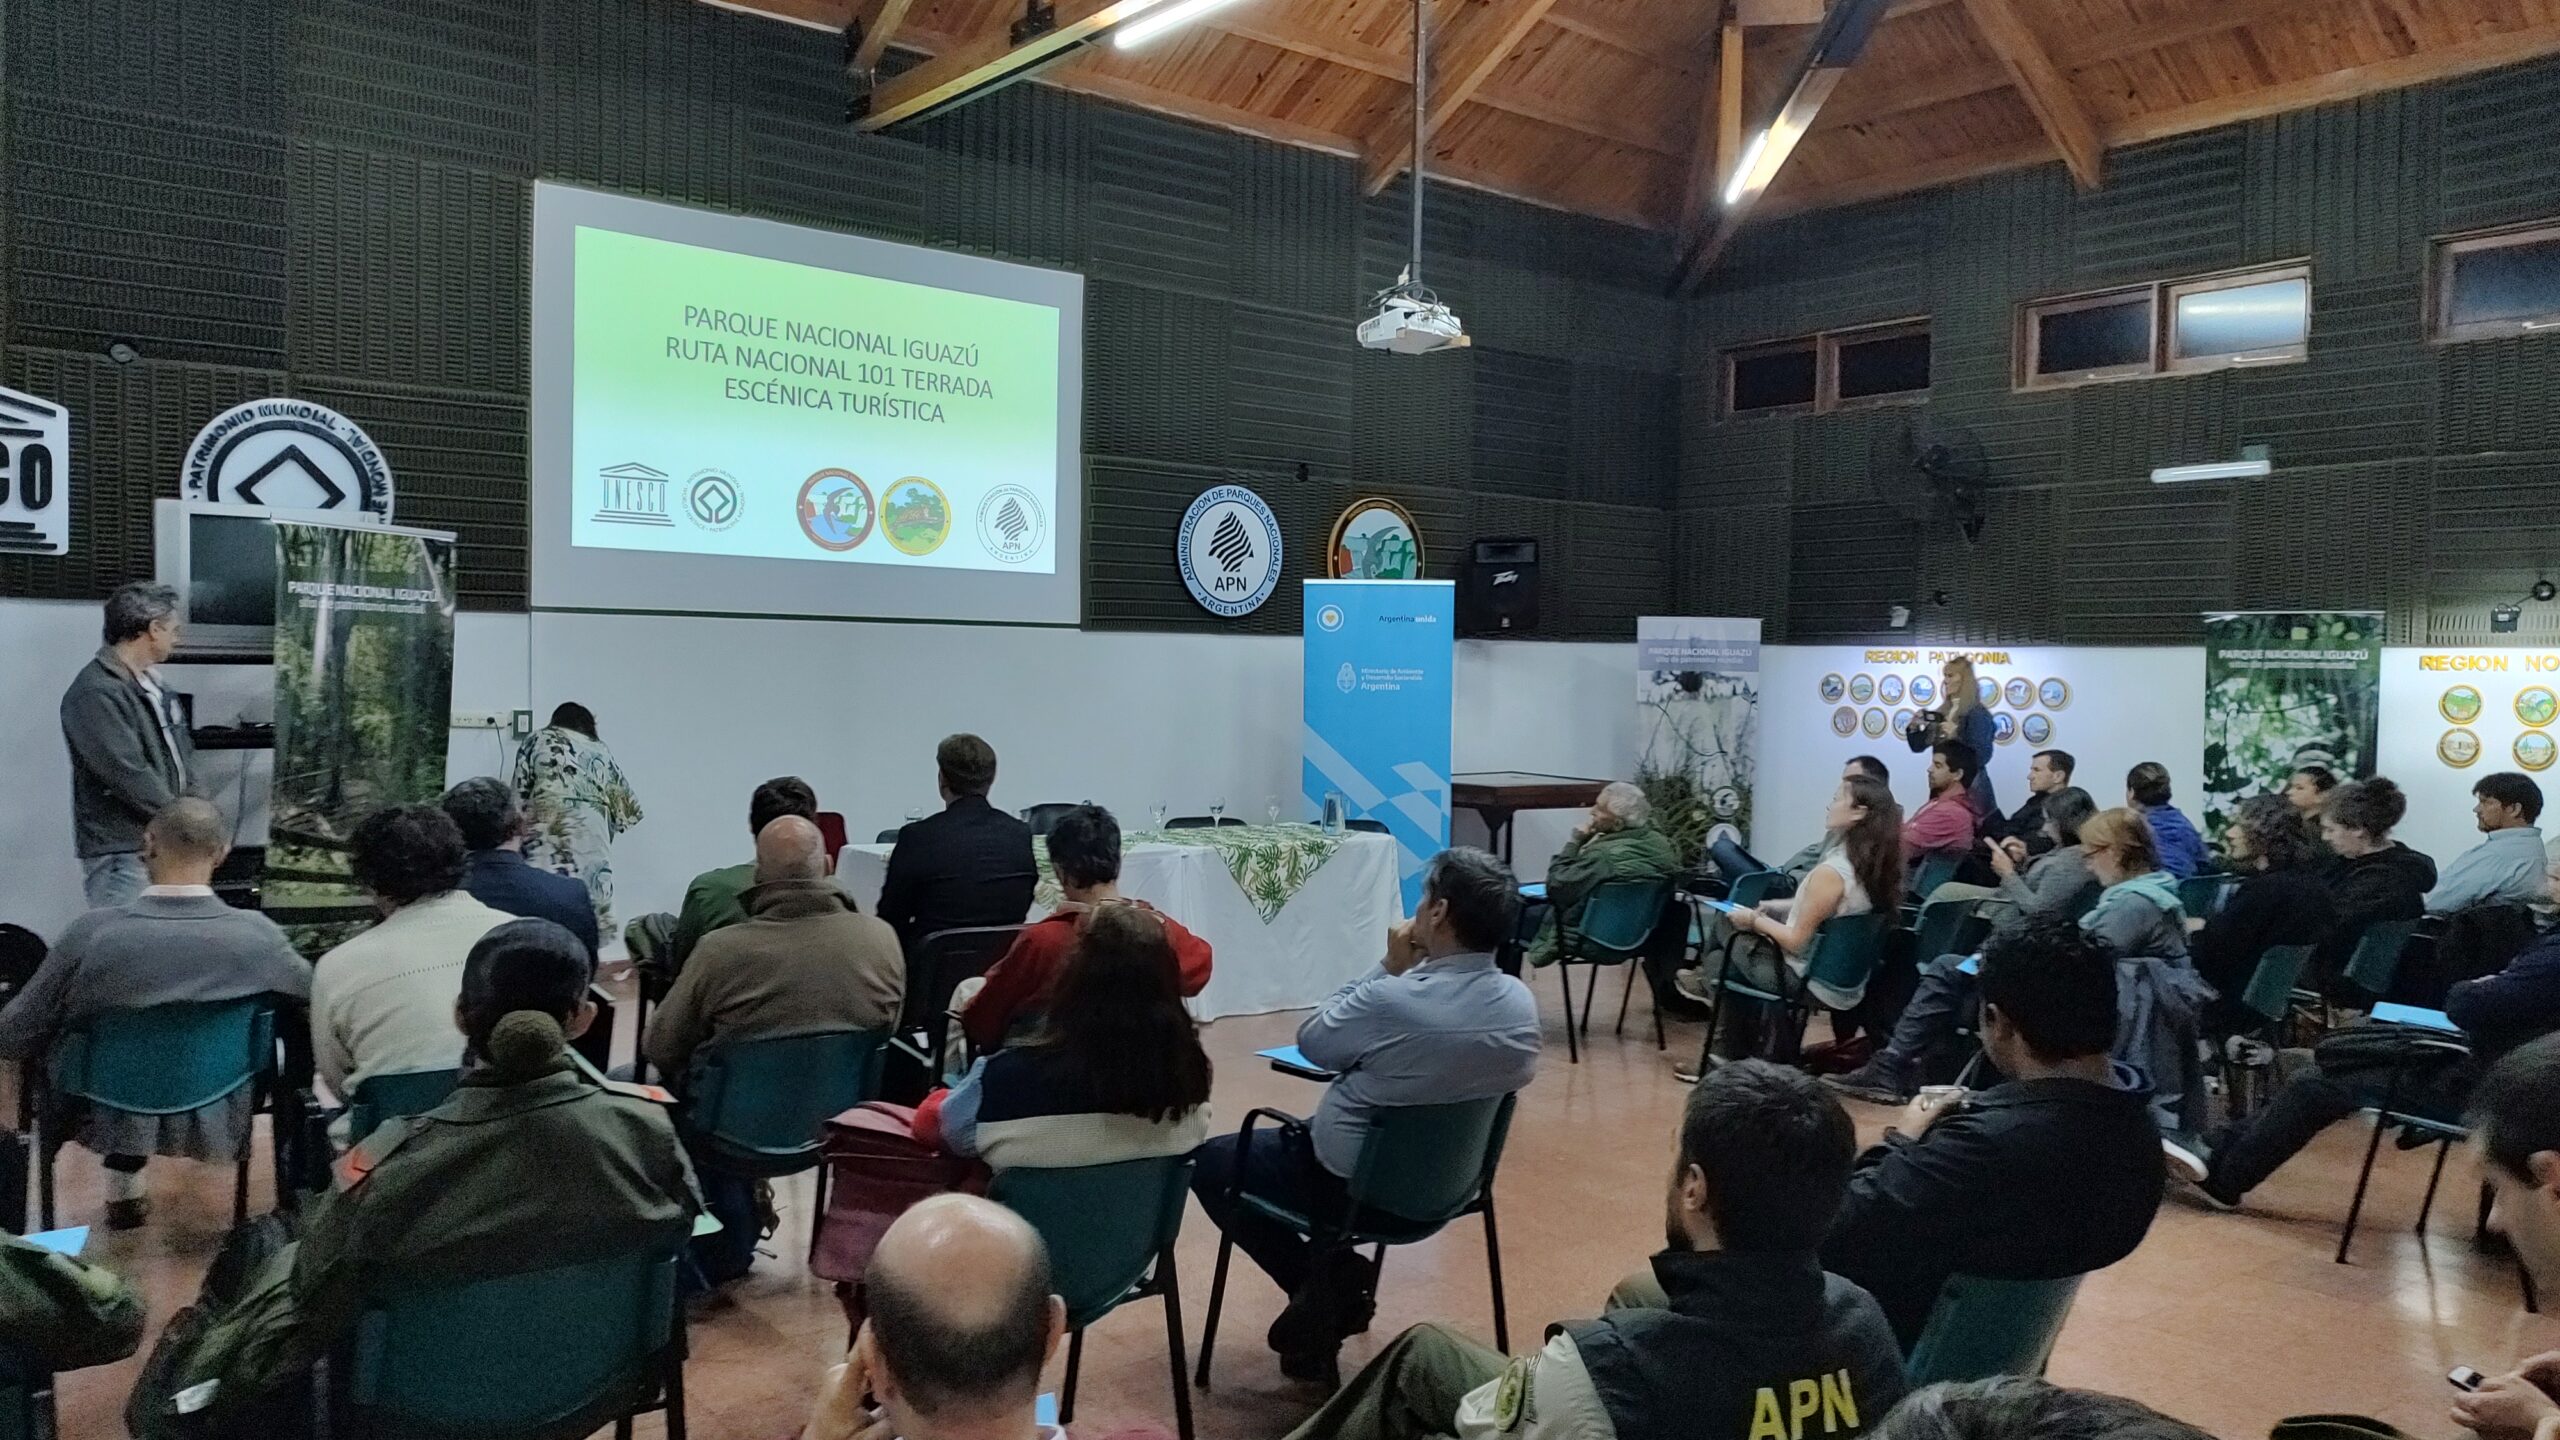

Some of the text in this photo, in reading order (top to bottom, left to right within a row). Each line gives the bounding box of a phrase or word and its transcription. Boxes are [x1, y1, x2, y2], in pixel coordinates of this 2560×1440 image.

[684, 304, 978, 367] PARQUE NACIONAL IGUAZÚ
[666, 336, 993, 399] RUTA NACIONAL 101 TERRADA
[725, 378, 945, 423] ESCÉNICA TURÍSTICA
[188, 403, 337, 490] PATRIMONIO MUNDIAL
[346, 427, 389, 497] MONDIAL
[603, 478, 666, 513] UNESCO
[1002, 541, 1021, 551] APN
[1179, 488, 1280, 583] ADMINISTRACION DE PARQUES NACIONALES
[1214, 576, 1248, 592] APN
[1200, 595, 1264, 615] ARGENTINA
[1681, 647, 1721, 657] NACIONAL
[1864, 649, 1919, 664] REGION
[2419, 655, 2509, 671] REGION
[1360, 681, 1401, 692] Argentina
[1748, 1368, 1860, 1440] APN
